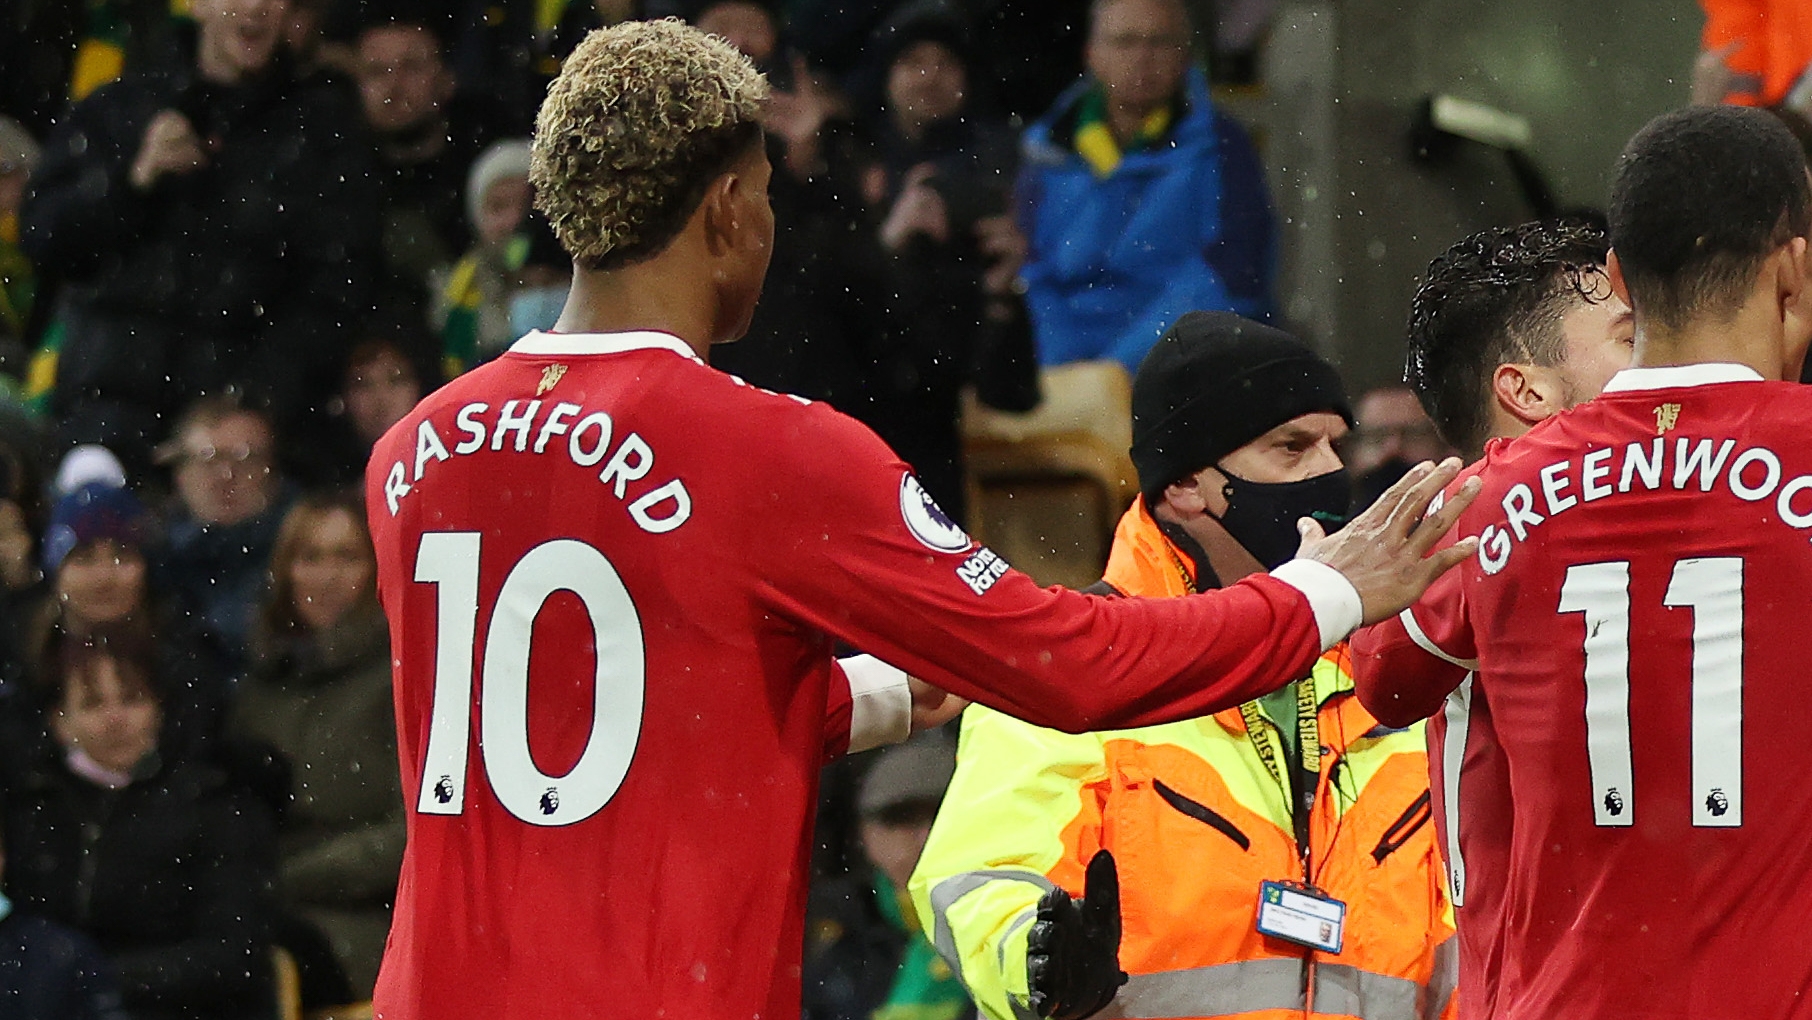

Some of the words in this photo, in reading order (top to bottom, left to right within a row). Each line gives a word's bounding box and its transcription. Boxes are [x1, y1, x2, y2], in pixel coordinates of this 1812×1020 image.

[384, 400, 692, 534] RASHFORD
[955, 557, 986, 585] No
[413, 531, 647, 827] 10
[1297, 677, 1317, 717] SAFETY
[1557, 556, 1744, 827] 11
[1241, 700, 1275, 761] STEWAR
[1299, 718, 1320, 773] STEWARD
